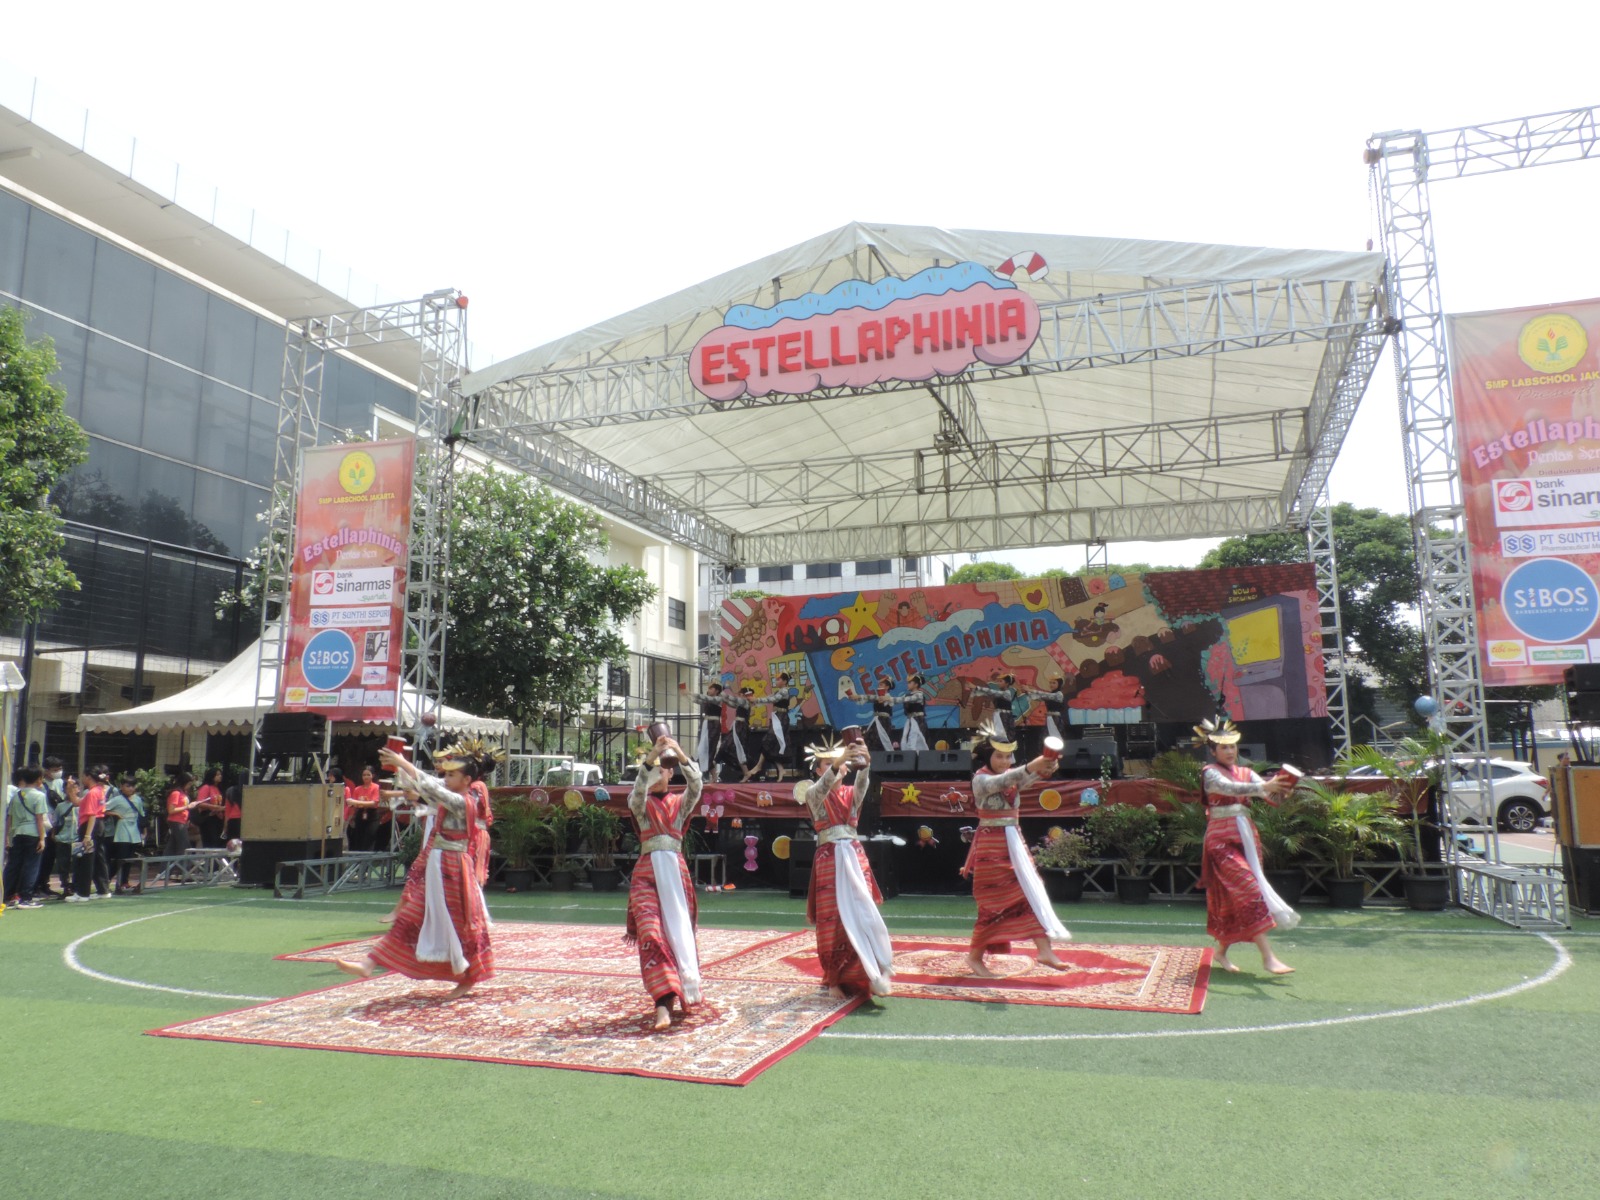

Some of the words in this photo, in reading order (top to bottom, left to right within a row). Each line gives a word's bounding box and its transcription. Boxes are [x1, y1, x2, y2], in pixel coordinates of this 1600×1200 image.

[702, 298, 1026, 385] ESTELLAPHINIA
[1485, 380, 1508, 390] SMP
[1512, 373, 1577, 388] LABSCHOOL
[1535, 478, 1565, 489] bank
[303, 526, 402, 562] Estellaphinia
[1539, 533, 1554, 545] PT
[336, 571, 353, 579] bank
[336, 579, 391, 592] sinarmas
[331, 611, 341, 620] PT
[860, 618, 1049, 698] ESTELLAPHINIA
